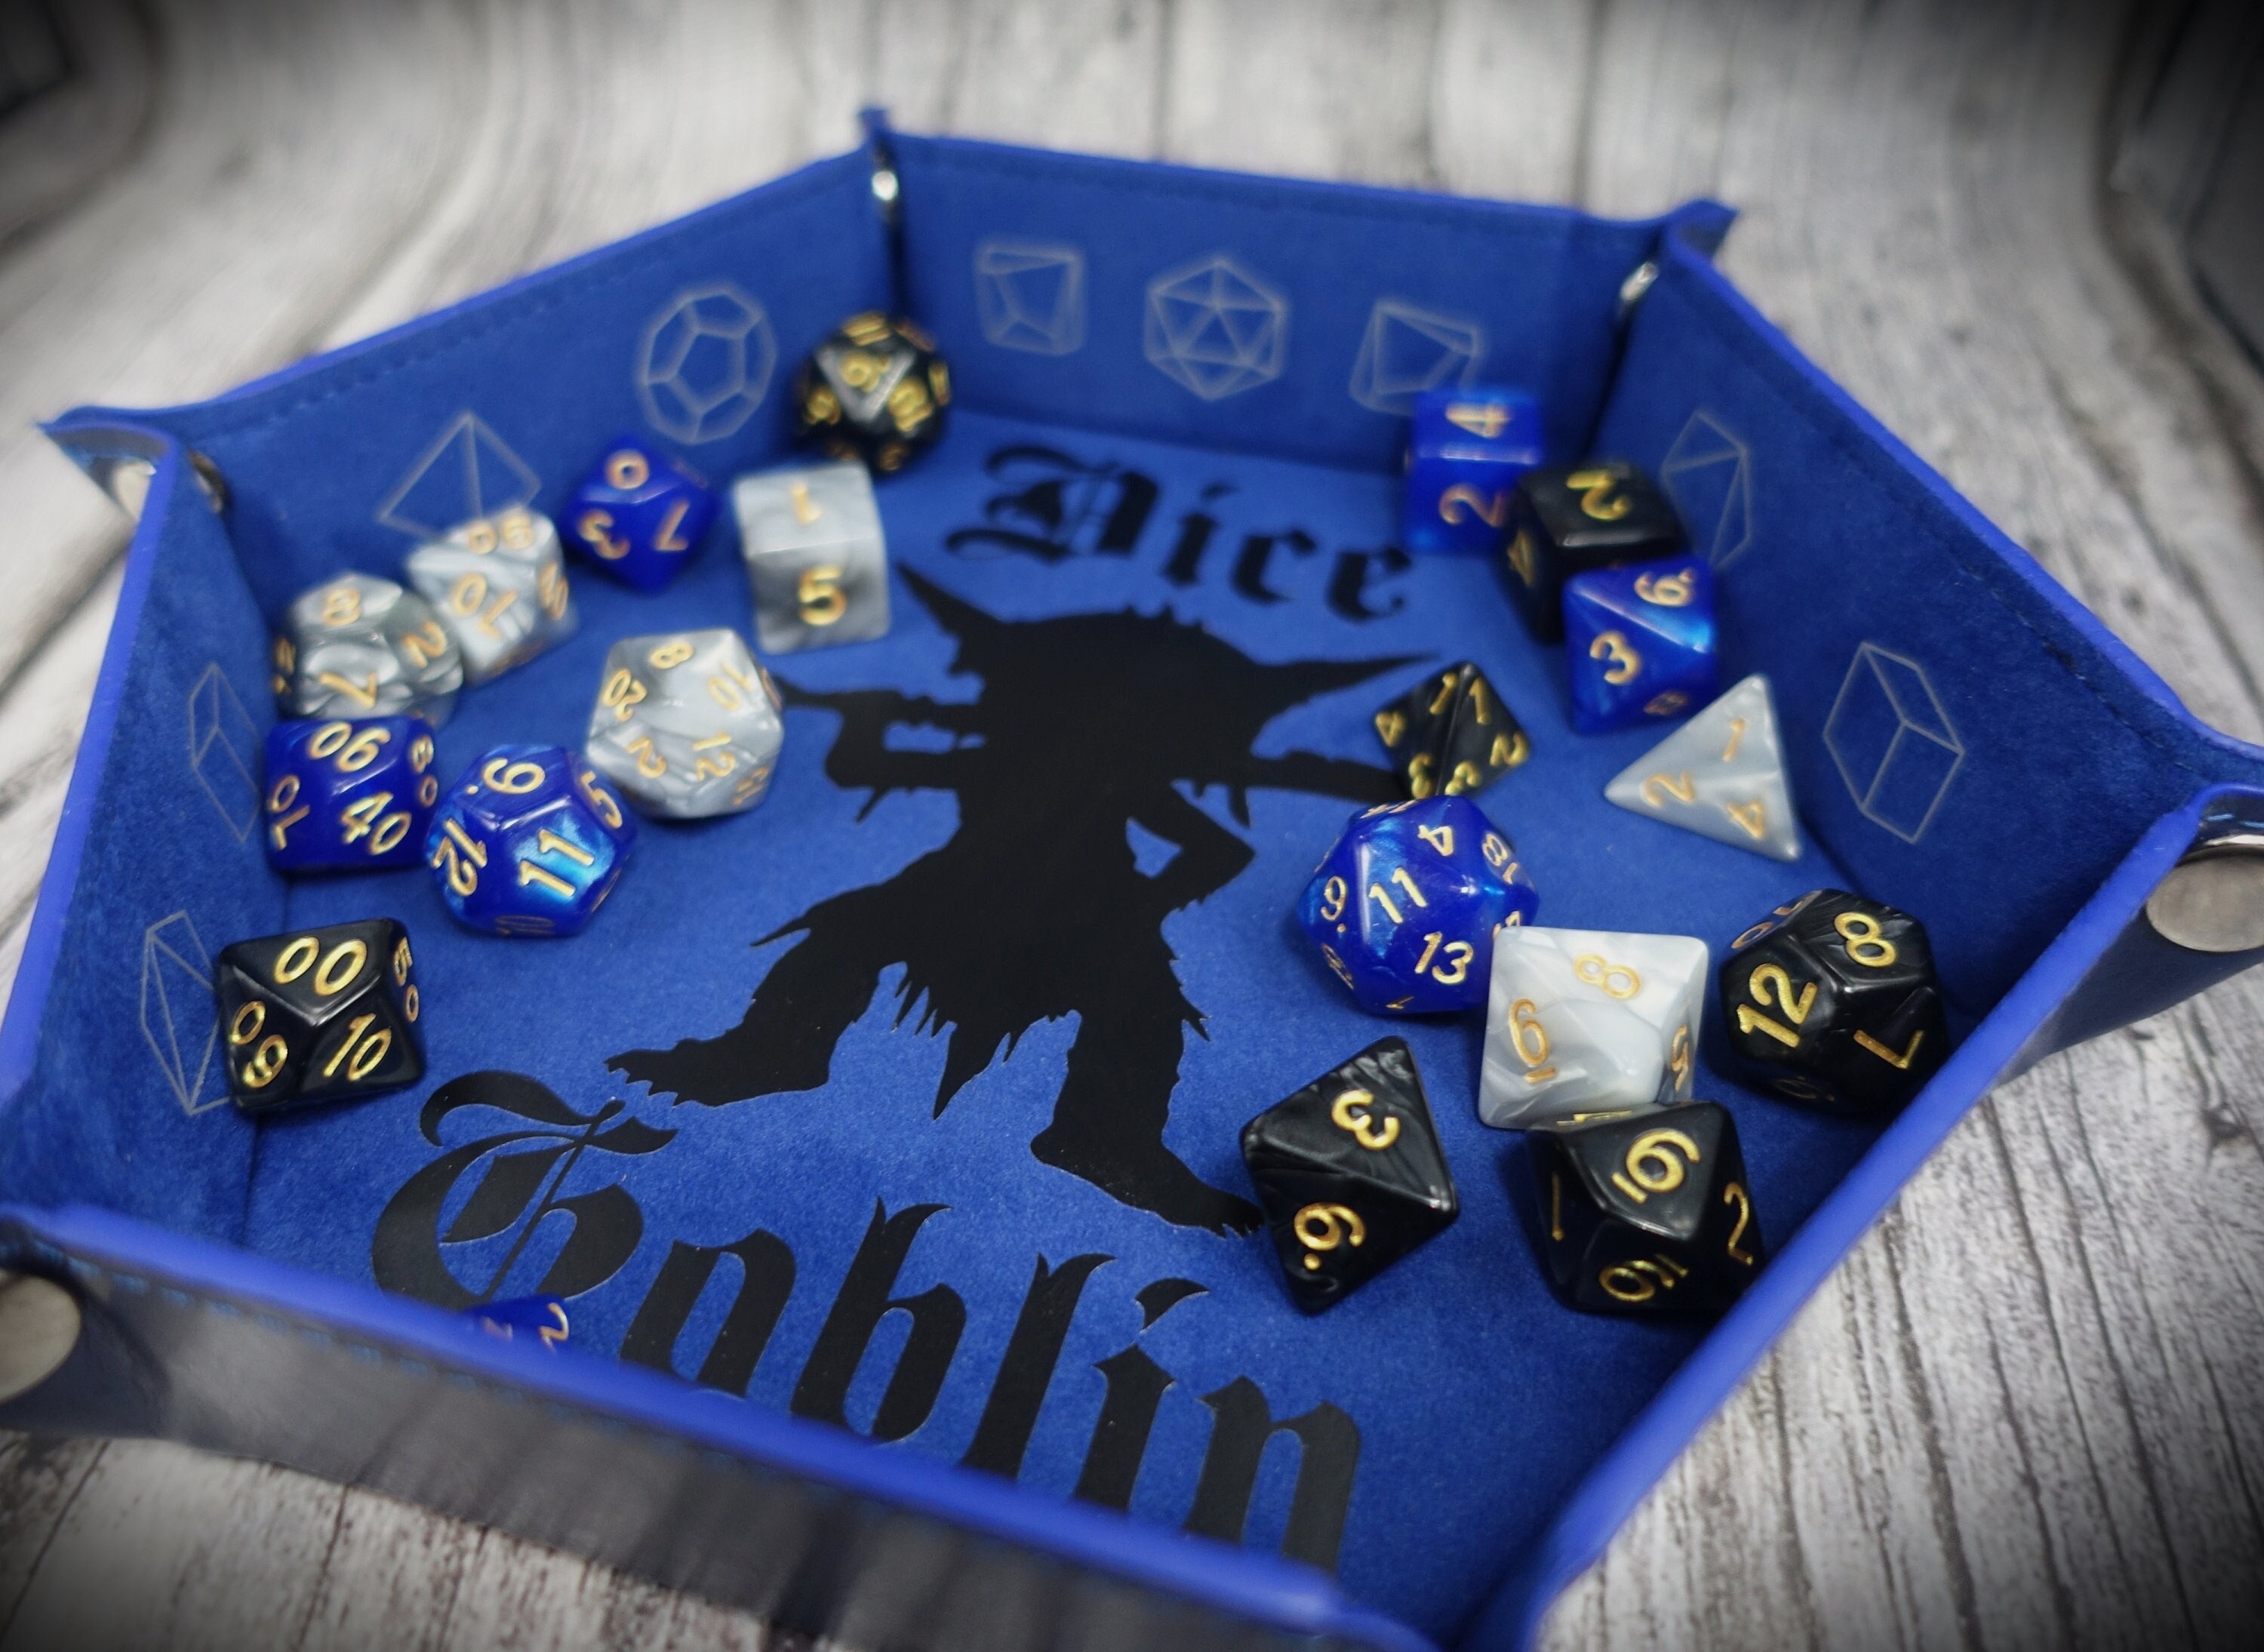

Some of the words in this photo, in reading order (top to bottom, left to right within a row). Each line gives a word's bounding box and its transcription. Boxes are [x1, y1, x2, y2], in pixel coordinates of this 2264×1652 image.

[1445, 403, 1512, 439] 4
[607, 449, 649, 490] 0
[1439, 484, 1506, 525] 2
[1565, 469, 1632, 521] 2
[579, 508, 631, 559] 3
[655, 500, 690, 552] 7
[945, 447, 1411, 625] Dice
[323, 588, 361, 626] 8
[798, 565, 847, 626] 5
[405, 621, 447, 668] 2
[649, 642, 694, 669] 8
[1589, 630, 1641, 685] 3
[319, 670, 376, 708] 7
[601, 668, 647, 721] 20
[708, 663, 752, 709] 10
[1429, 672, 1458, 715] 1
[1469, 678, 1489, 724] 1
[1376, 711, 1405, 747] 4
[1490, 732, 1530, 766] 2
[1723, 718, 1745, 761] 1
[626, 737, 667, 779] 2
[693, 731, 736, 781] 12
[1445, 761, 1481, 795] 3
[580, 771, 623, 829] 5
[1644, 771, 1694, 806] 2
[340, 792, 412, 855] 40
[1418, 825, 1453, 857] 4
[1728, 799, 1765, 840] 4
[431, 817, 488, 897] 12
[518, 829, 595, 897] 11
[1368, 868, 1426, 923] 11
[1414, 931, 1473, 985] 13
[1835, 912, 1896, 967] 8
[274, 936, 368, 996] 00
[1573, 953, 1640, 999] 8
[1737, 963, 1818, 1047] 12
[322, 1013, 392, 1081] 10
[1853, 1029, 1923, 1069] 7
[1332, 1089, 1401, 1149] 3
[1552, 1173, 1564, 1241] 1
[1724, 1183, 1754, 1266] 2
[371, 1070, 1361, 1575] Goblin
